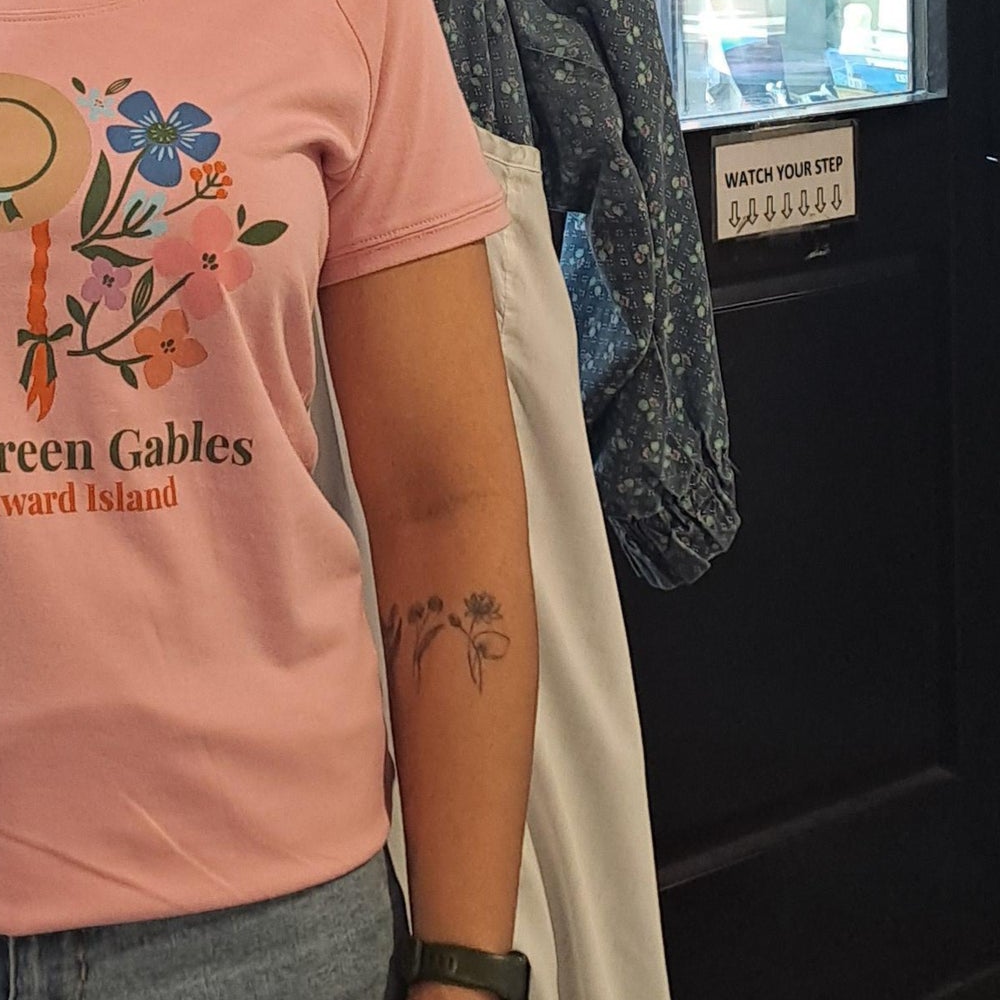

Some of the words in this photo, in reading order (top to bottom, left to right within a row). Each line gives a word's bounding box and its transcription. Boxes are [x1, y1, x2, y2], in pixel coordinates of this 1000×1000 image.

[725, 167, 773, 188] WATCH
[775, 161, 812, 180] YOUR
[814, 156, 843, 175] STEP
[109, 421, 254, 471] Gables
[86, 476, 178, 512] Island
